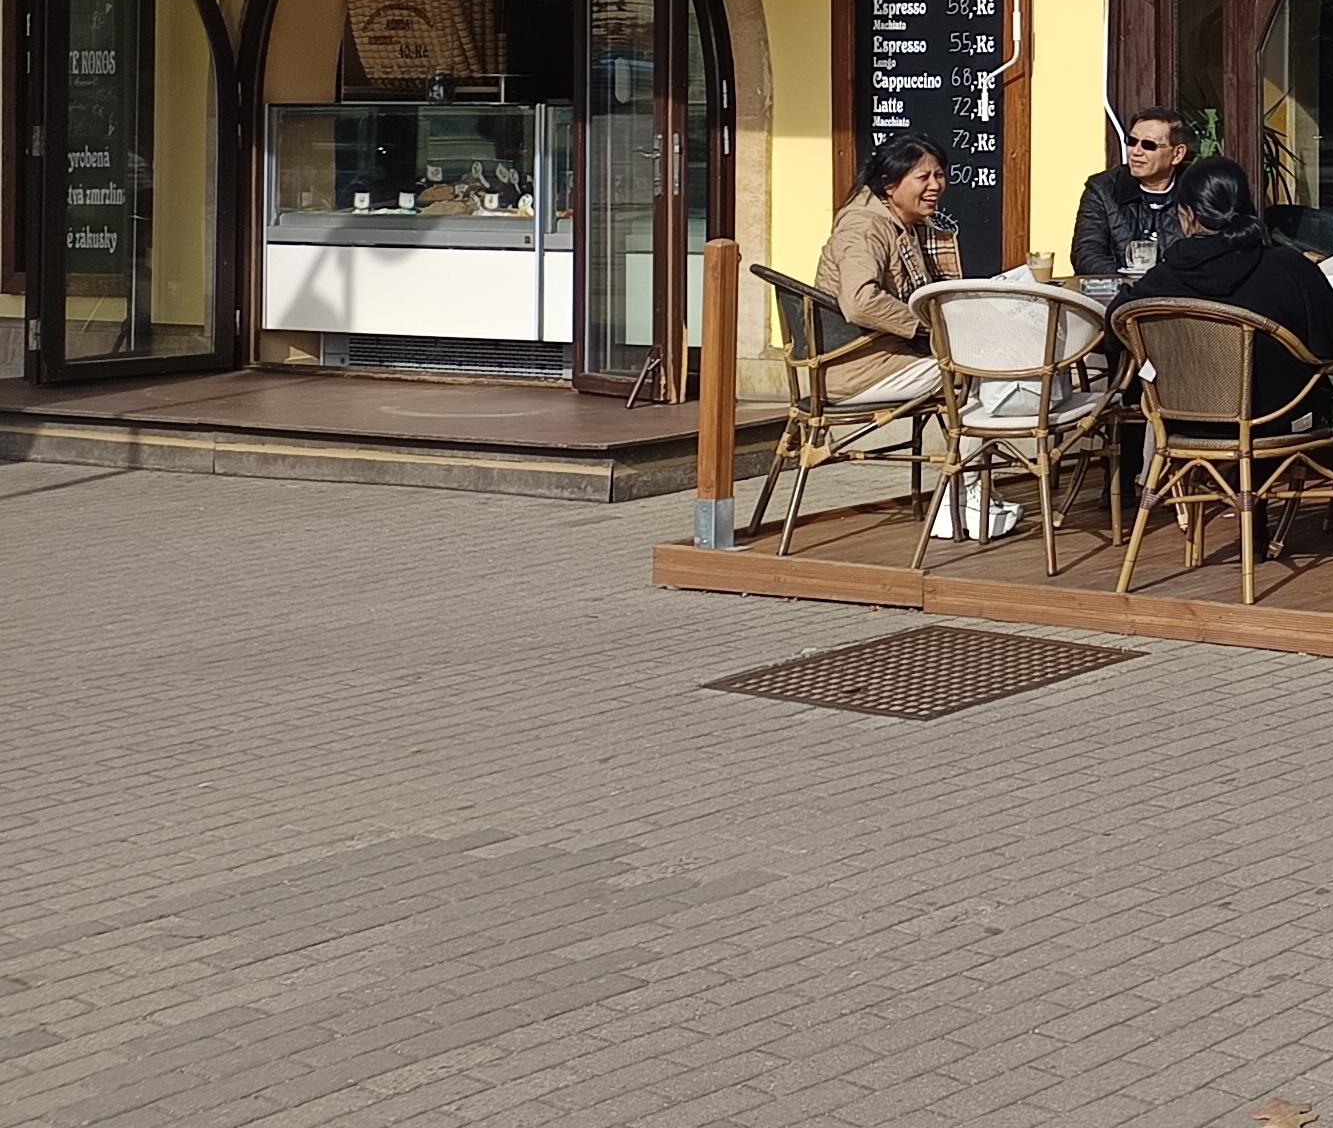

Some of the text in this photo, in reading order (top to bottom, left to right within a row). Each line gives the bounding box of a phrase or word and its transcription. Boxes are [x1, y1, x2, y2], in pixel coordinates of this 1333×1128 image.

[873, 36, 927, 56] Espresso
[873, 71, 942, 92] Cappuccino
[873, 96, 904, 113] Latte
[75, 225, 118, 254] zákusky
